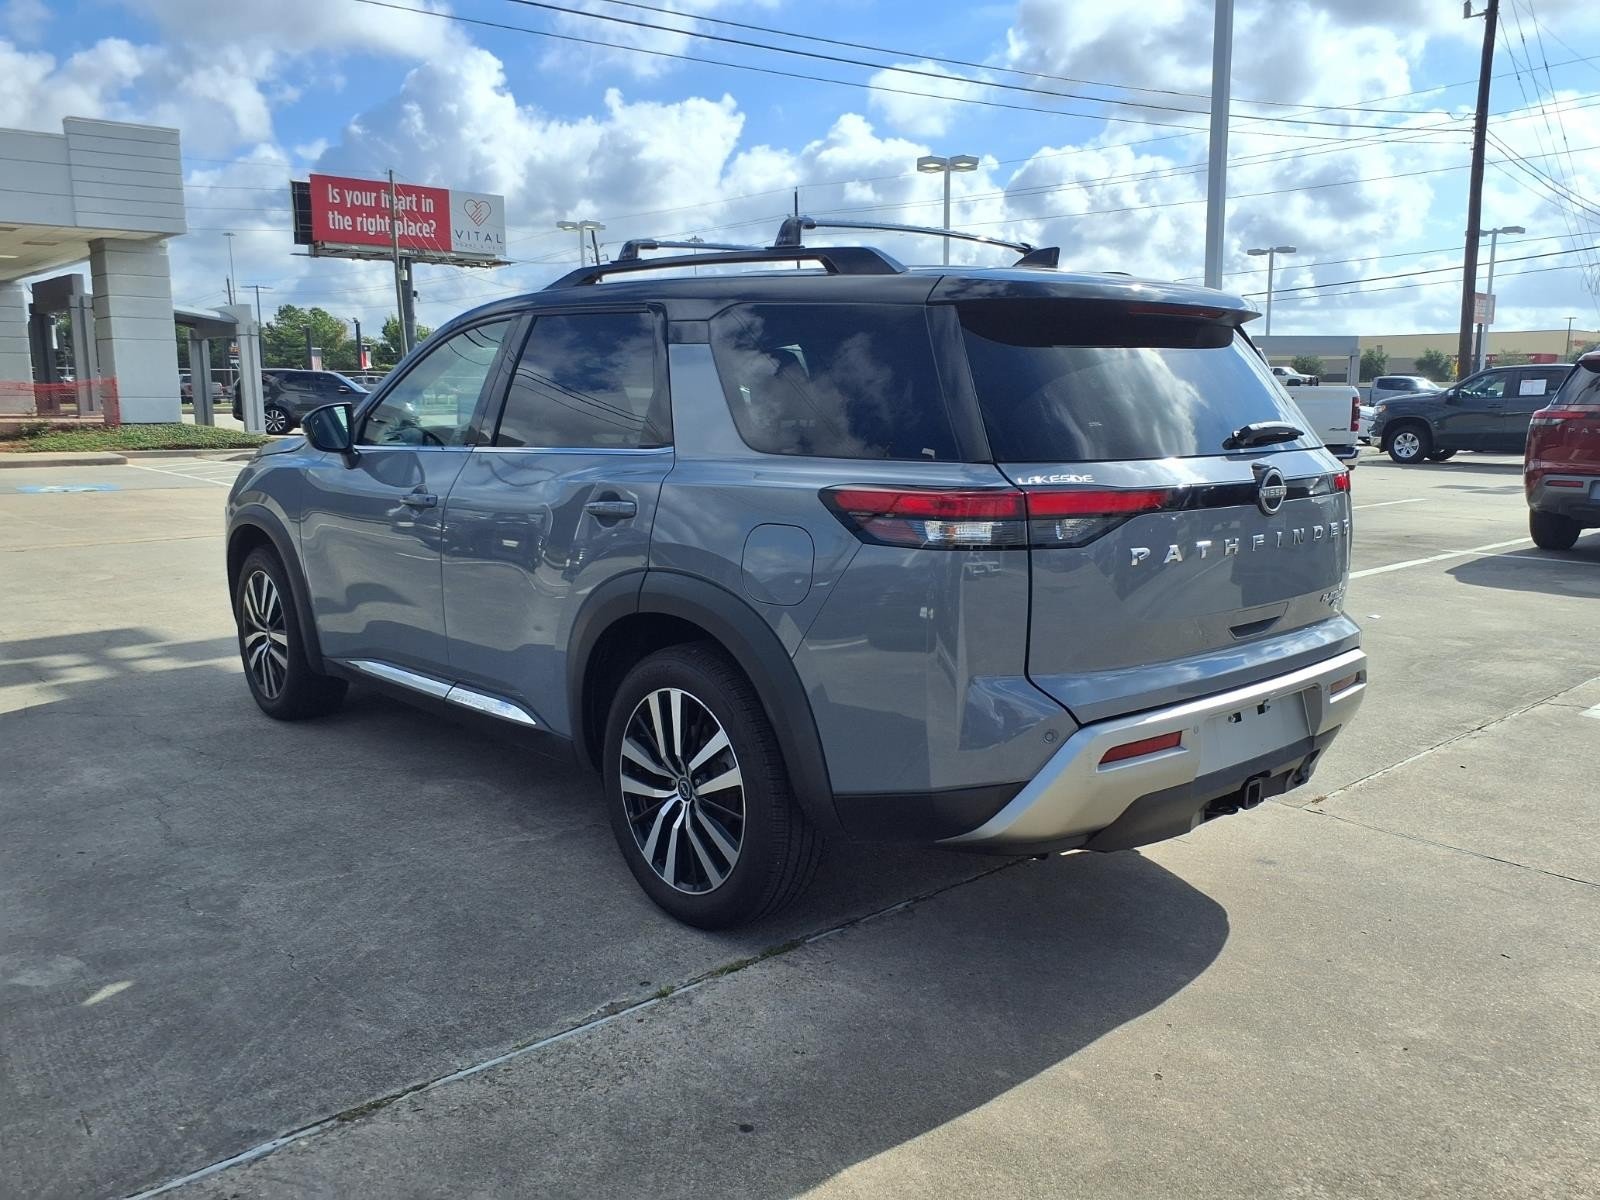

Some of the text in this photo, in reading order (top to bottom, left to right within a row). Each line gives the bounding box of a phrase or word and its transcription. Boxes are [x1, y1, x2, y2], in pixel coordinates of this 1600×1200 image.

[327, 183, 435, 213] Is your heart in
[327, 210, 437, 238] the right place?
[454, 229, 503, 244] VITAL
[1017, 474, 1096, 485] LAKESIDE
